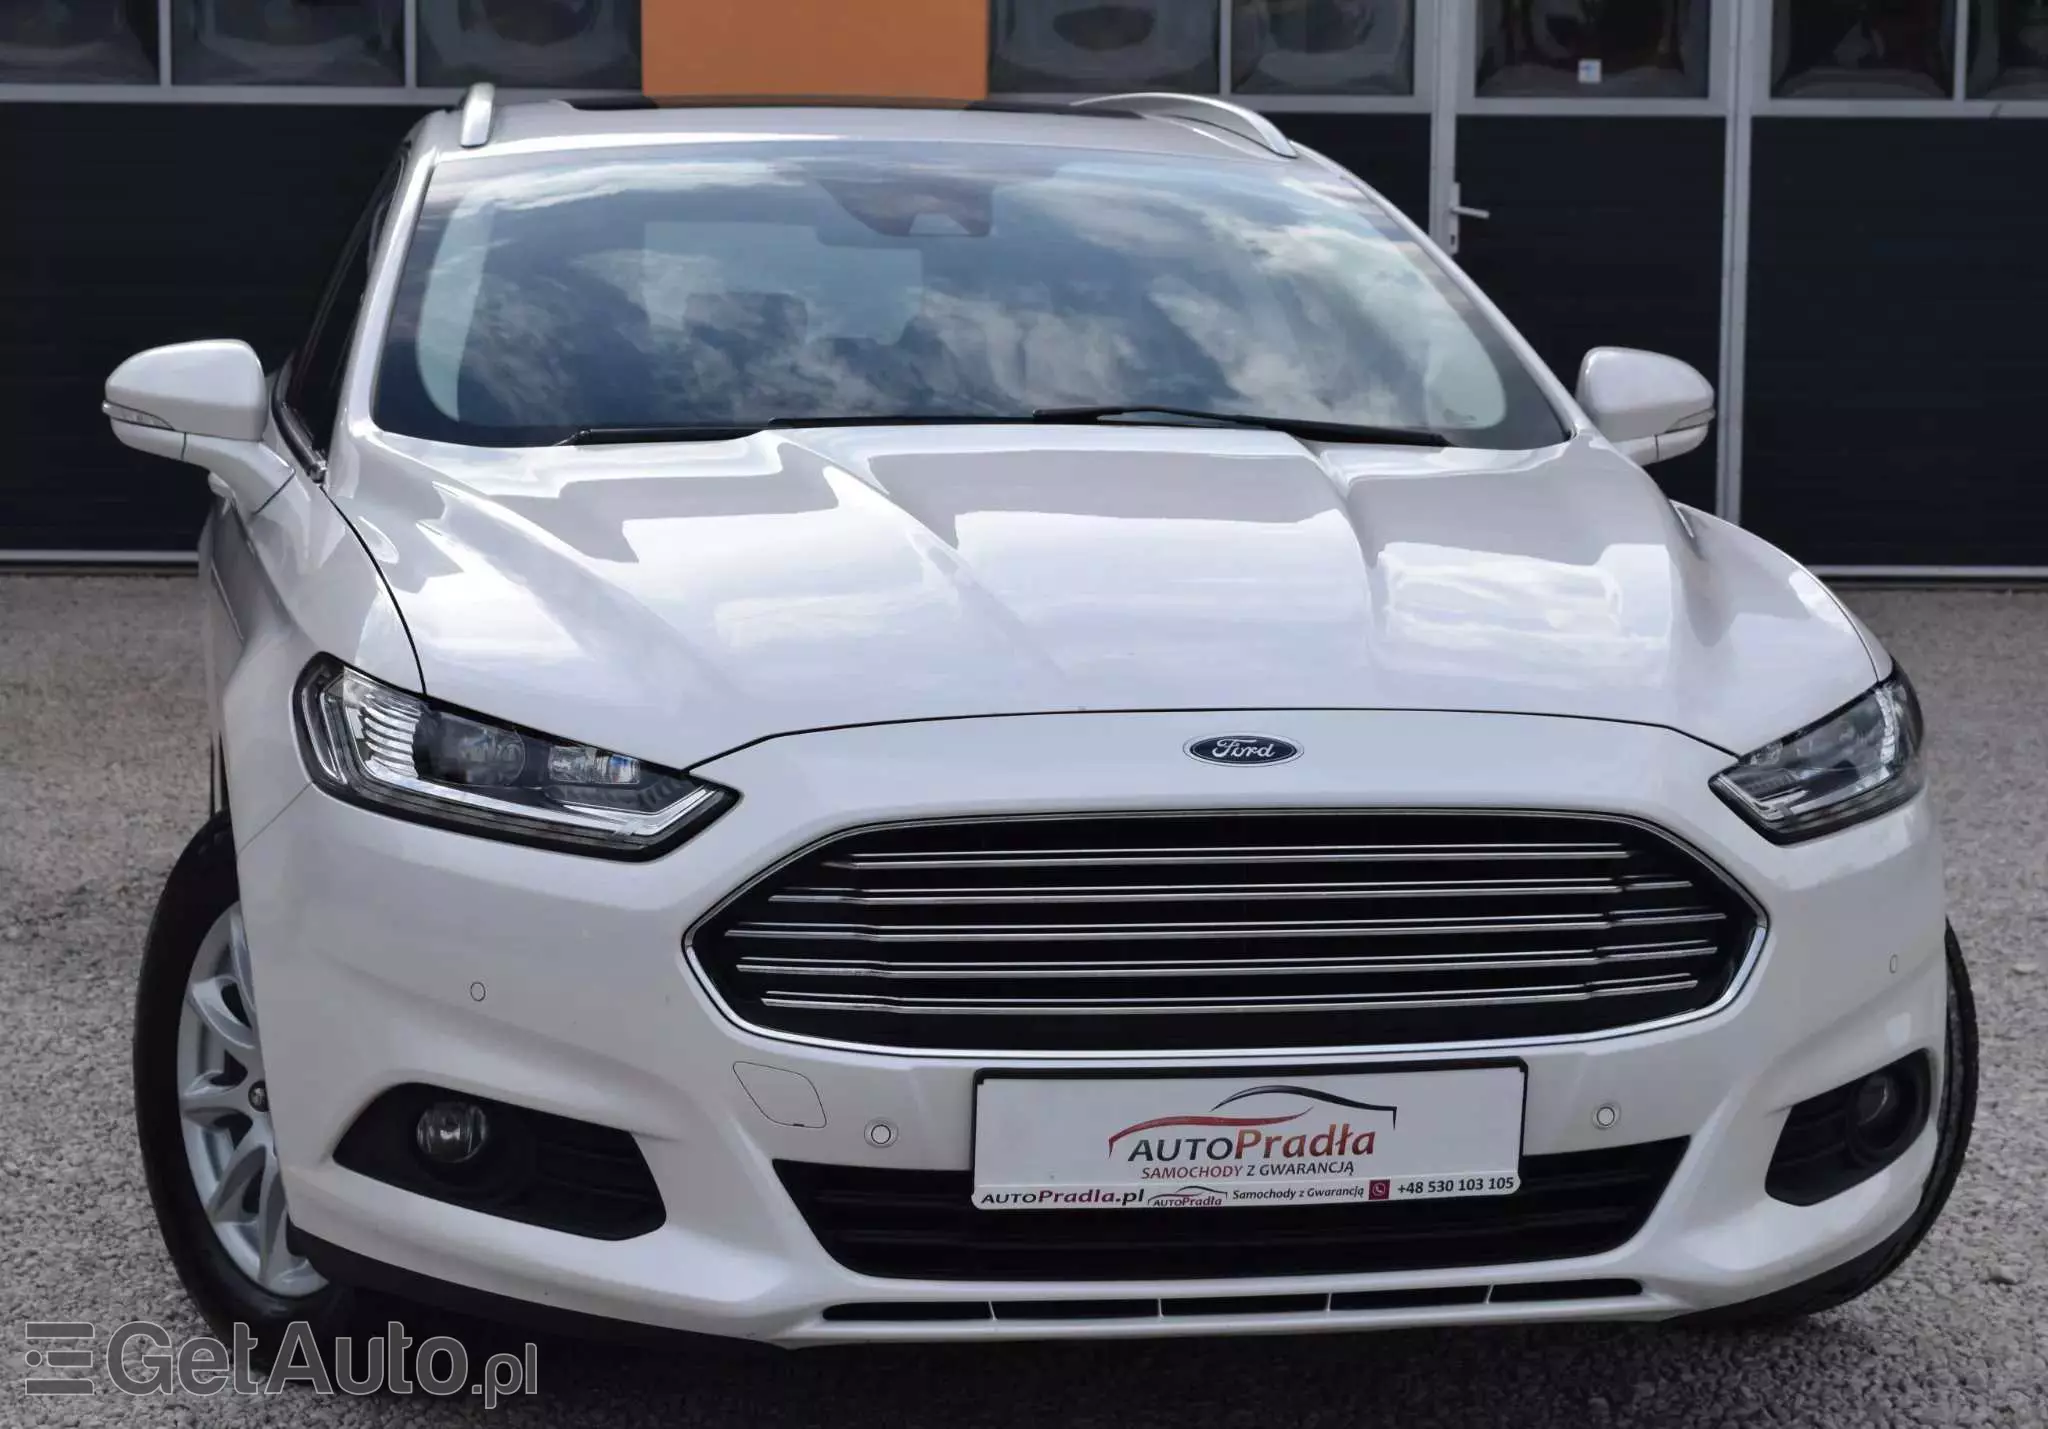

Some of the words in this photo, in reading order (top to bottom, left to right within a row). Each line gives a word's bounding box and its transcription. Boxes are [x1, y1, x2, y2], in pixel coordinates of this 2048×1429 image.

[1212, 738, 1275, 758] Ford
[1127, 1123, 1376, 1162] AUTOPradła
[1141, 1165, 1243, 1180] SAMOCHODY
[1246, 1164, 1257, 1177] Z
[1259, 1160, 1355, 1177] GWARANCJĄ
[1232, 1188, 1297, 1201] Samochody
[1306, 1186, 1365, 1198] Gwarancją
[1397, 1180, 1424, 1194] +48
[1428, 1179, 1454, 1193] 530
[1458, 1178, 1484, 1192] 103
[1489, 1177, 1515, 1190] 105
[981, 1188, 1144, 1206] AUTOPradla.pl
